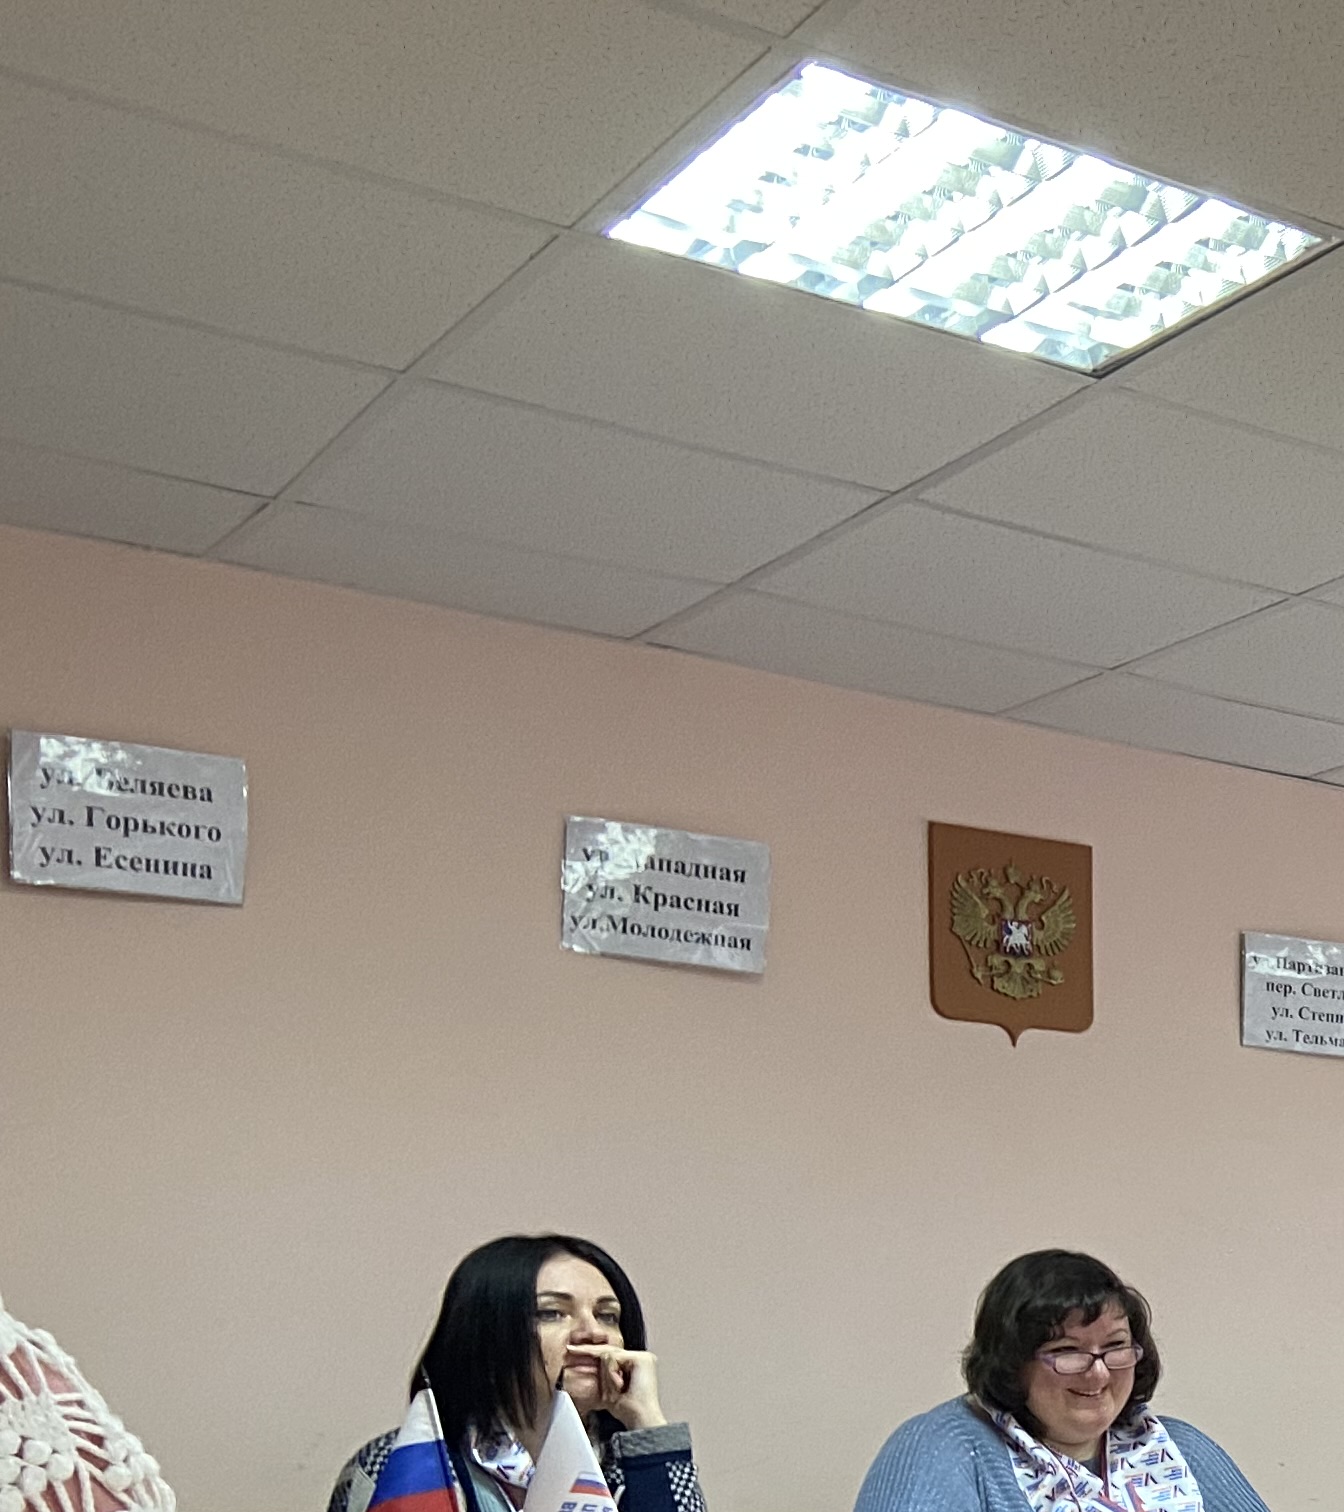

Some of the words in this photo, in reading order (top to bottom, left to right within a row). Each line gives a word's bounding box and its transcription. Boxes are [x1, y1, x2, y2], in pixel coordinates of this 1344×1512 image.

[31, 805, 74, 828] ул.
[85, 805, 222, 843] Горького
[39, 846, 82, 867] ул.
[94, 846, 213, 880] Есенина
[635, 853, 746, 883] ападная
[633, 884, 740, 917] Красная
[1266, 981, 1296, 997] пер.
[1271, 1006, 1293, 1020] ул.
[1265, 1029, 1287, 1043] ул.
